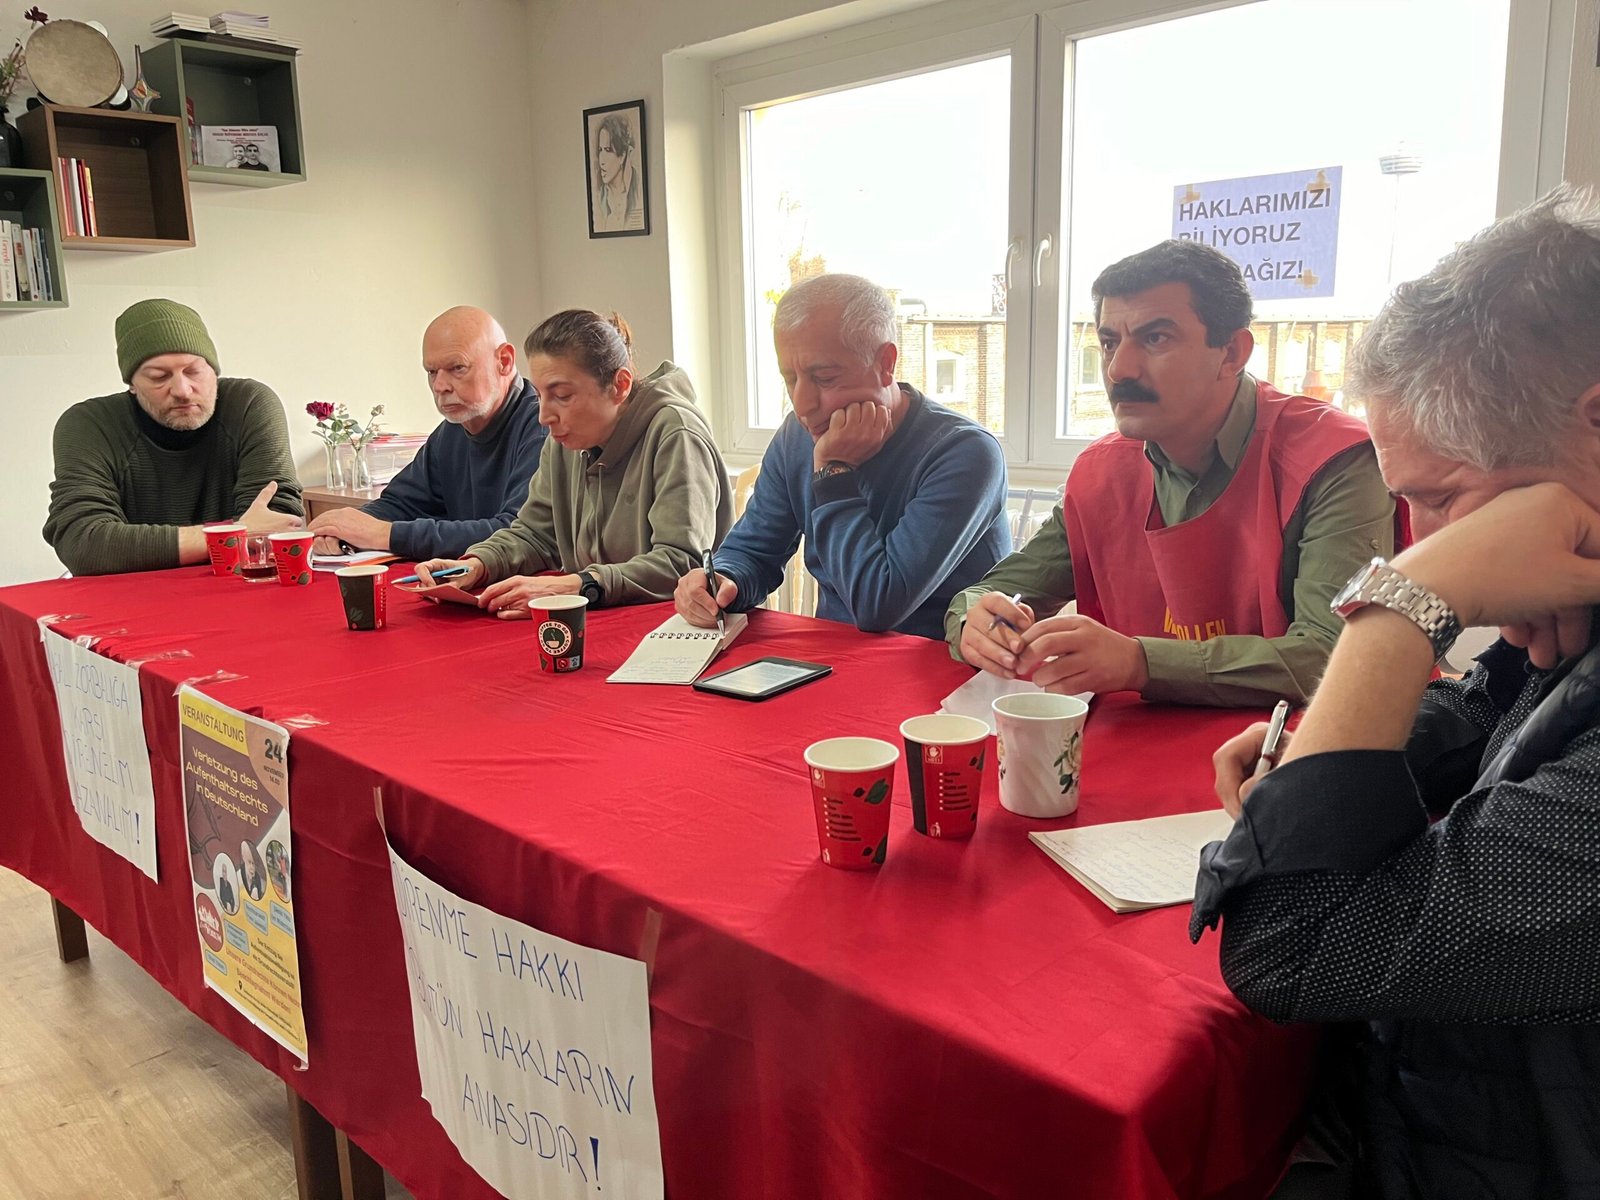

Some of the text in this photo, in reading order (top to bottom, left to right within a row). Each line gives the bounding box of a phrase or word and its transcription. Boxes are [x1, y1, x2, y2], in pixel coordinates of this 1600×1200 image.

[1179, 188, 1331, 221] HAKLARIMIZI
[182, 704, 245, 743] VERANSTALTUNG
[192, 746, 259, 791] Verletzung des
[264, 738, 284, 764] 24
[185, 761, 269, 814] Aufenthaltsrechts
[204, 787, 259, 827] Deutschland
[492, 927, 584, 1002] HAKKI
[476, 1009, 635, 1115] HAKLARIN
